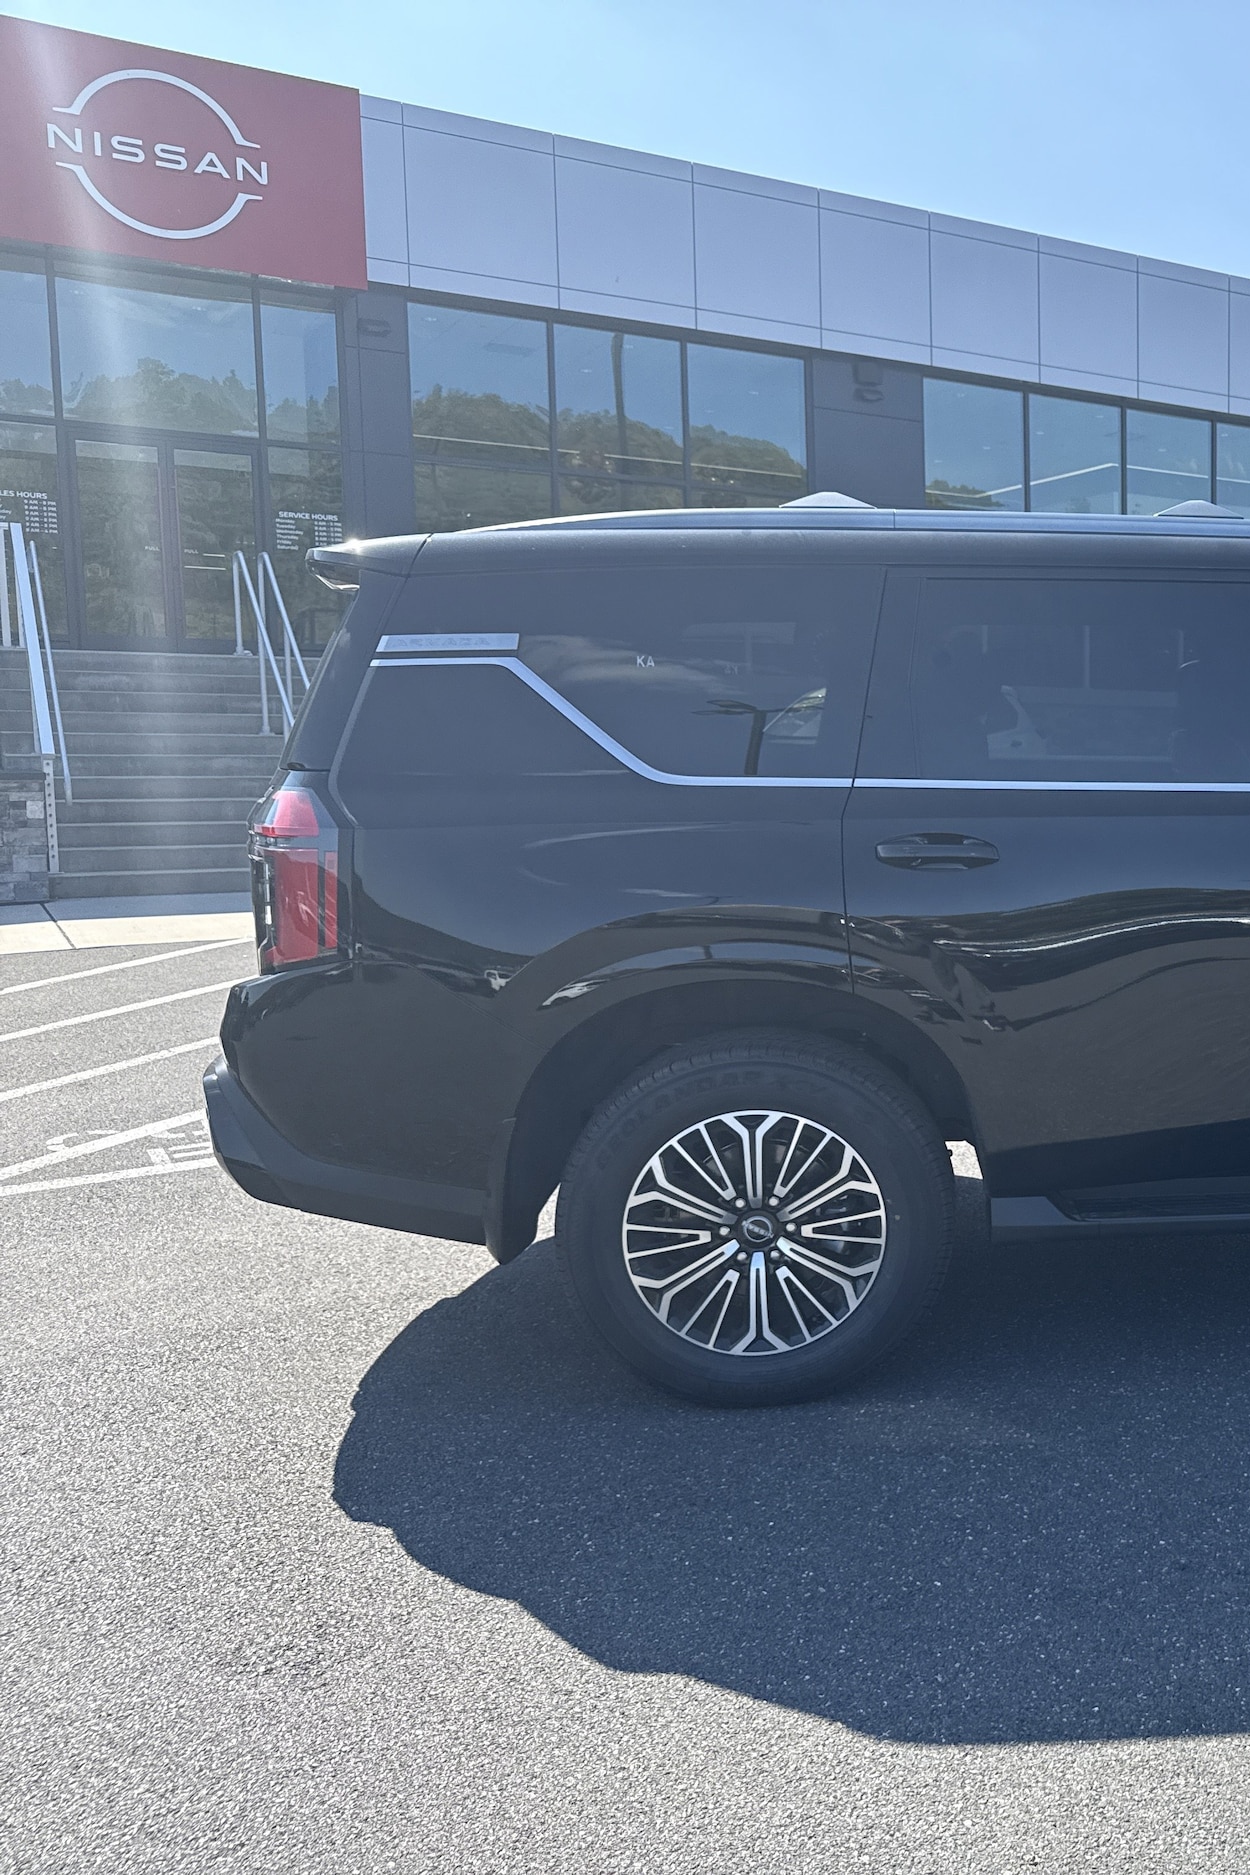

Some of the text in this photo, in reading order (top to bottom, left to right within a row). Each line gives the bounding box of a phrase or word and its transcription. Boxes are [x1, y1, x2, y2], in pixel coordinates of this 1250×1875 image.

[46, 122, 269, 186] NISSAN
[16, 491, 47, 499] HOURS
[279, 511, 310, 519] SERVICE
[636, 656, 655, 668] KA
